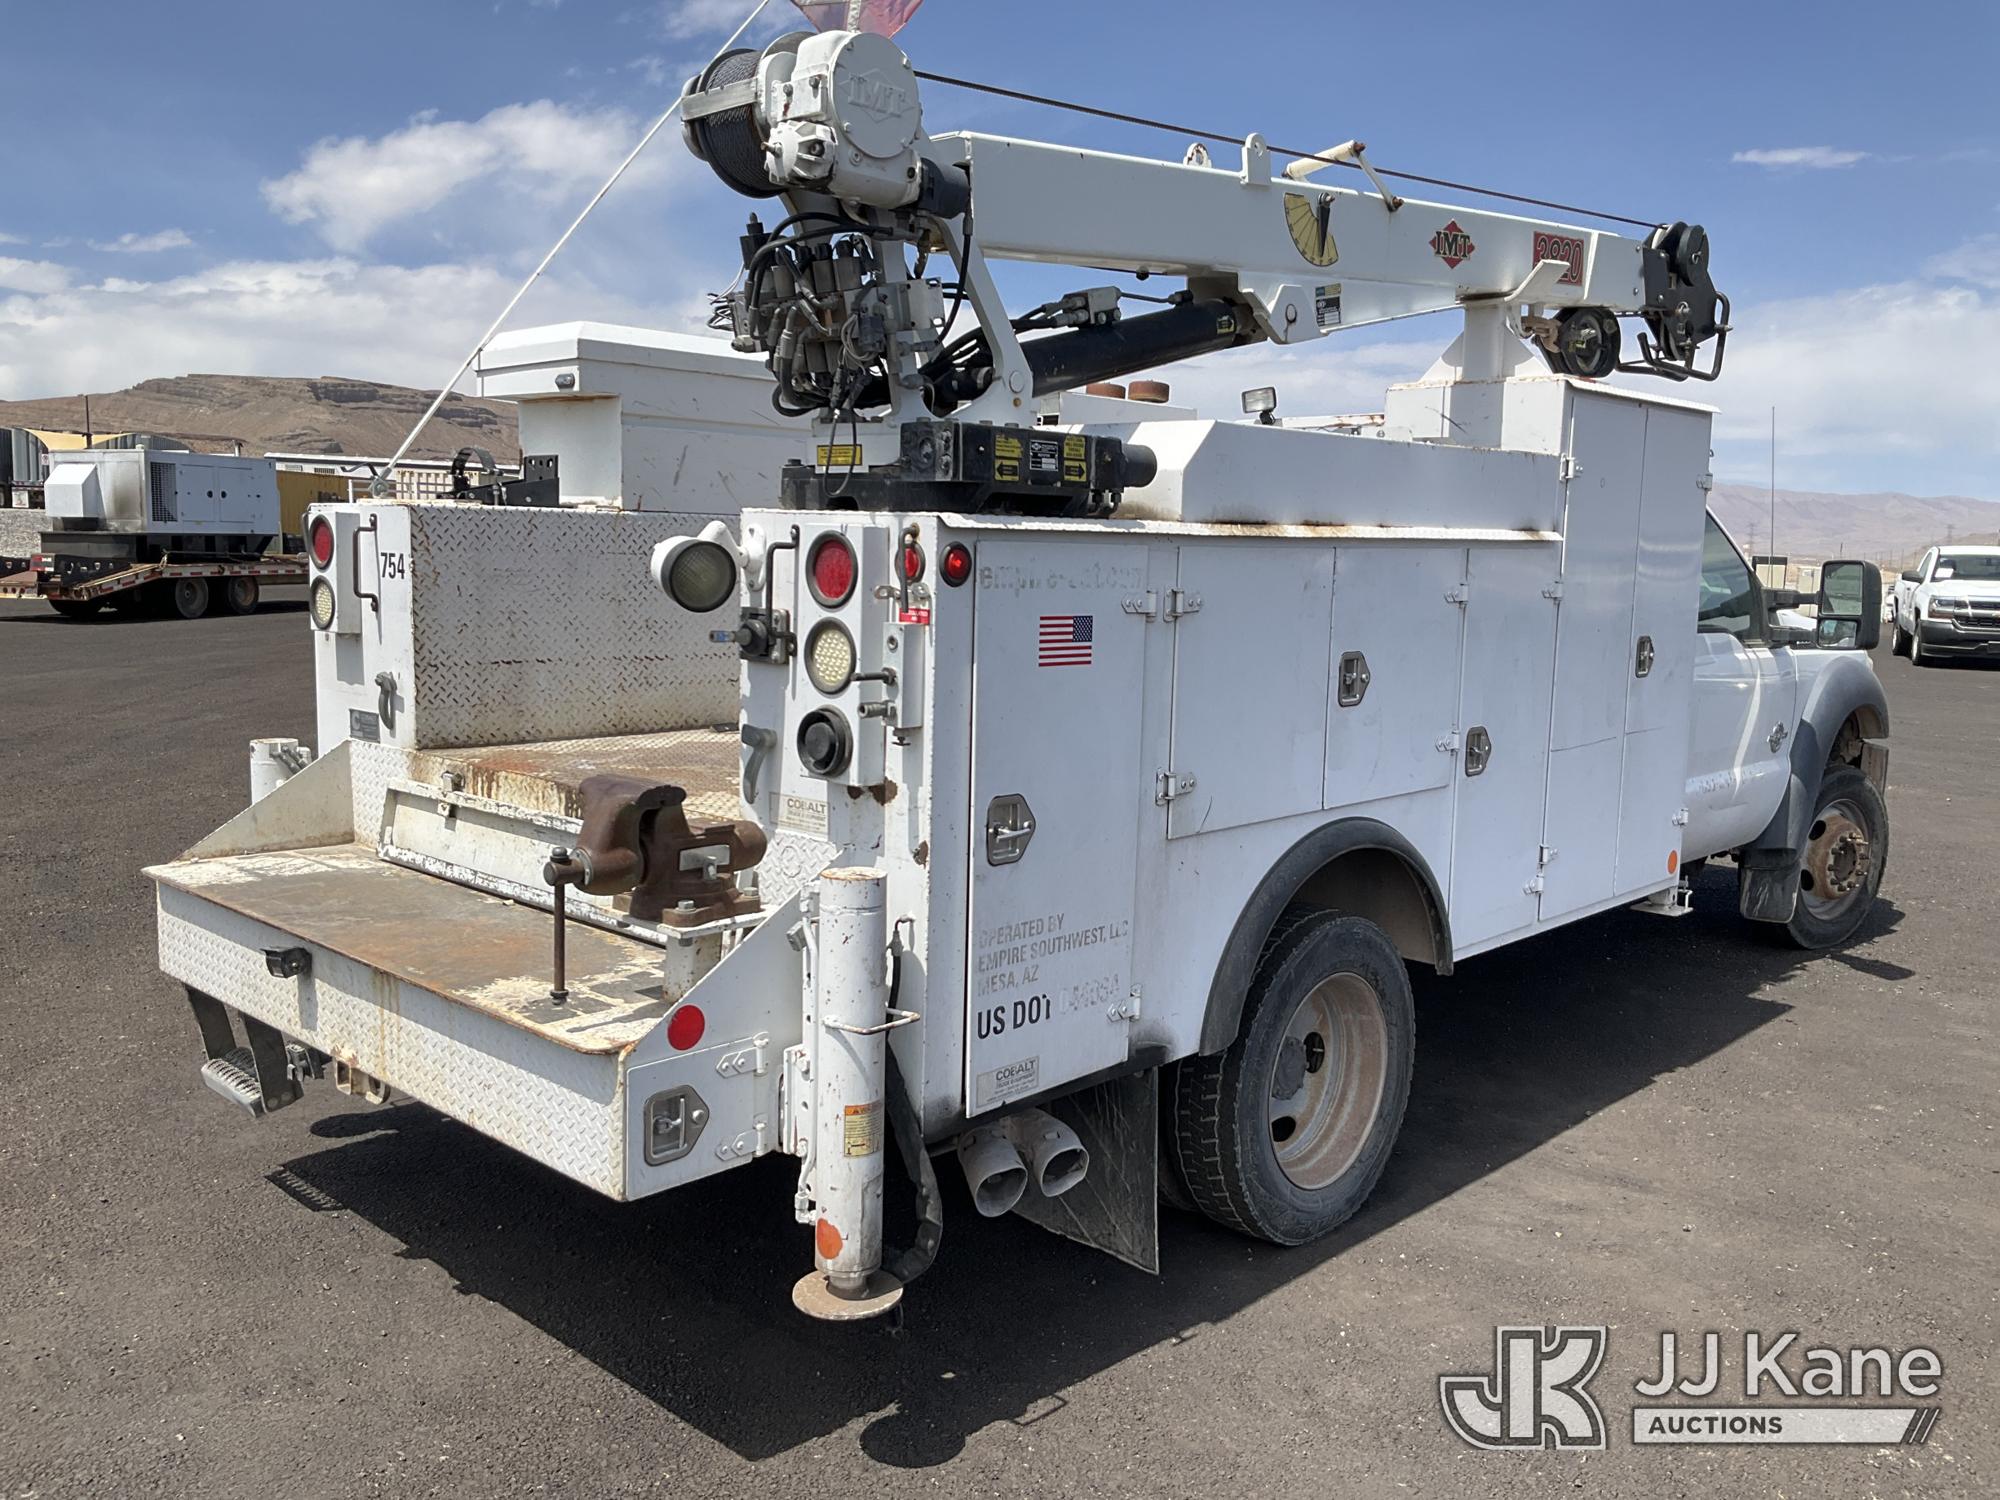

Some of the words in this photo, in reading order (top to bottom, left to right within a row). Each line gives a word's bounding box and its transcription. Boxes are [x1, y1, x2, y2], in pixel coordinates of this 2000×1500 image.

[848, 72, 905, 117] IMT
[1435, 231, 1470, 258] IMT
[381, 552, 405, 579] 754
[979, 918, 1044, 948] OPERATED
[1048, 913, 1064, 933] BY
[978, 944, 1027, 972] EMPIRE
[1030, 926, 1106, 959] SOUTHWEST,
[1022, 965, 1040, 984] AZ
[977, 1005, 1006, 1040] US
